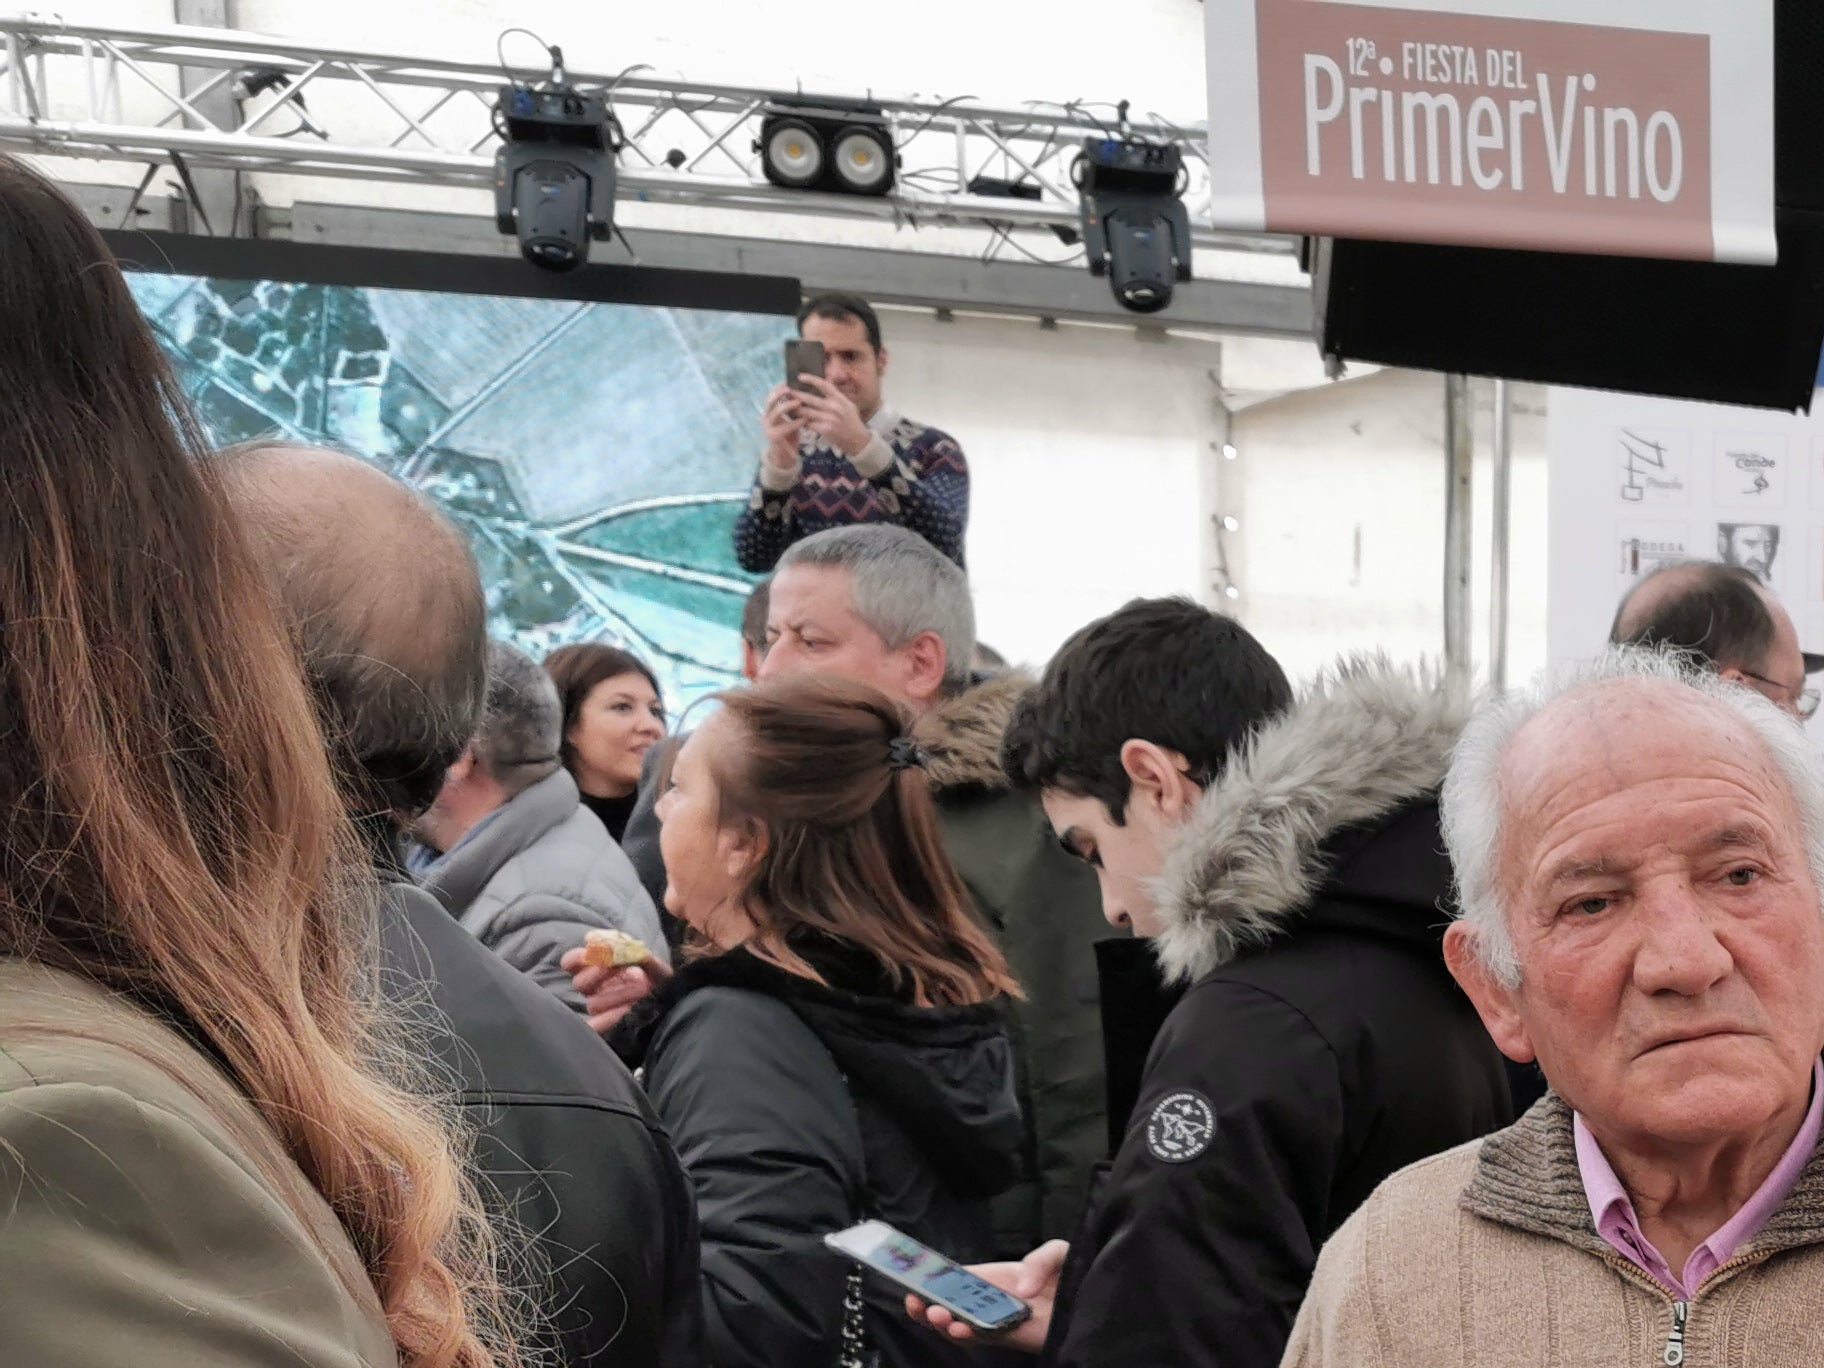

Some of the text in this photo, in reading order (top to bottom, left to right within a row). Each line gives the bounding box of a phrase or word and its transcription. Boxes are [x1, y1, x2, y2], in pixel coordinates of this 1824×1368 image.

[1402, 41, 1479, 86] FIESTA
[1486, 48, 1528, 90] DEL
[1303, 53, 1683, 202] PrimerVino
